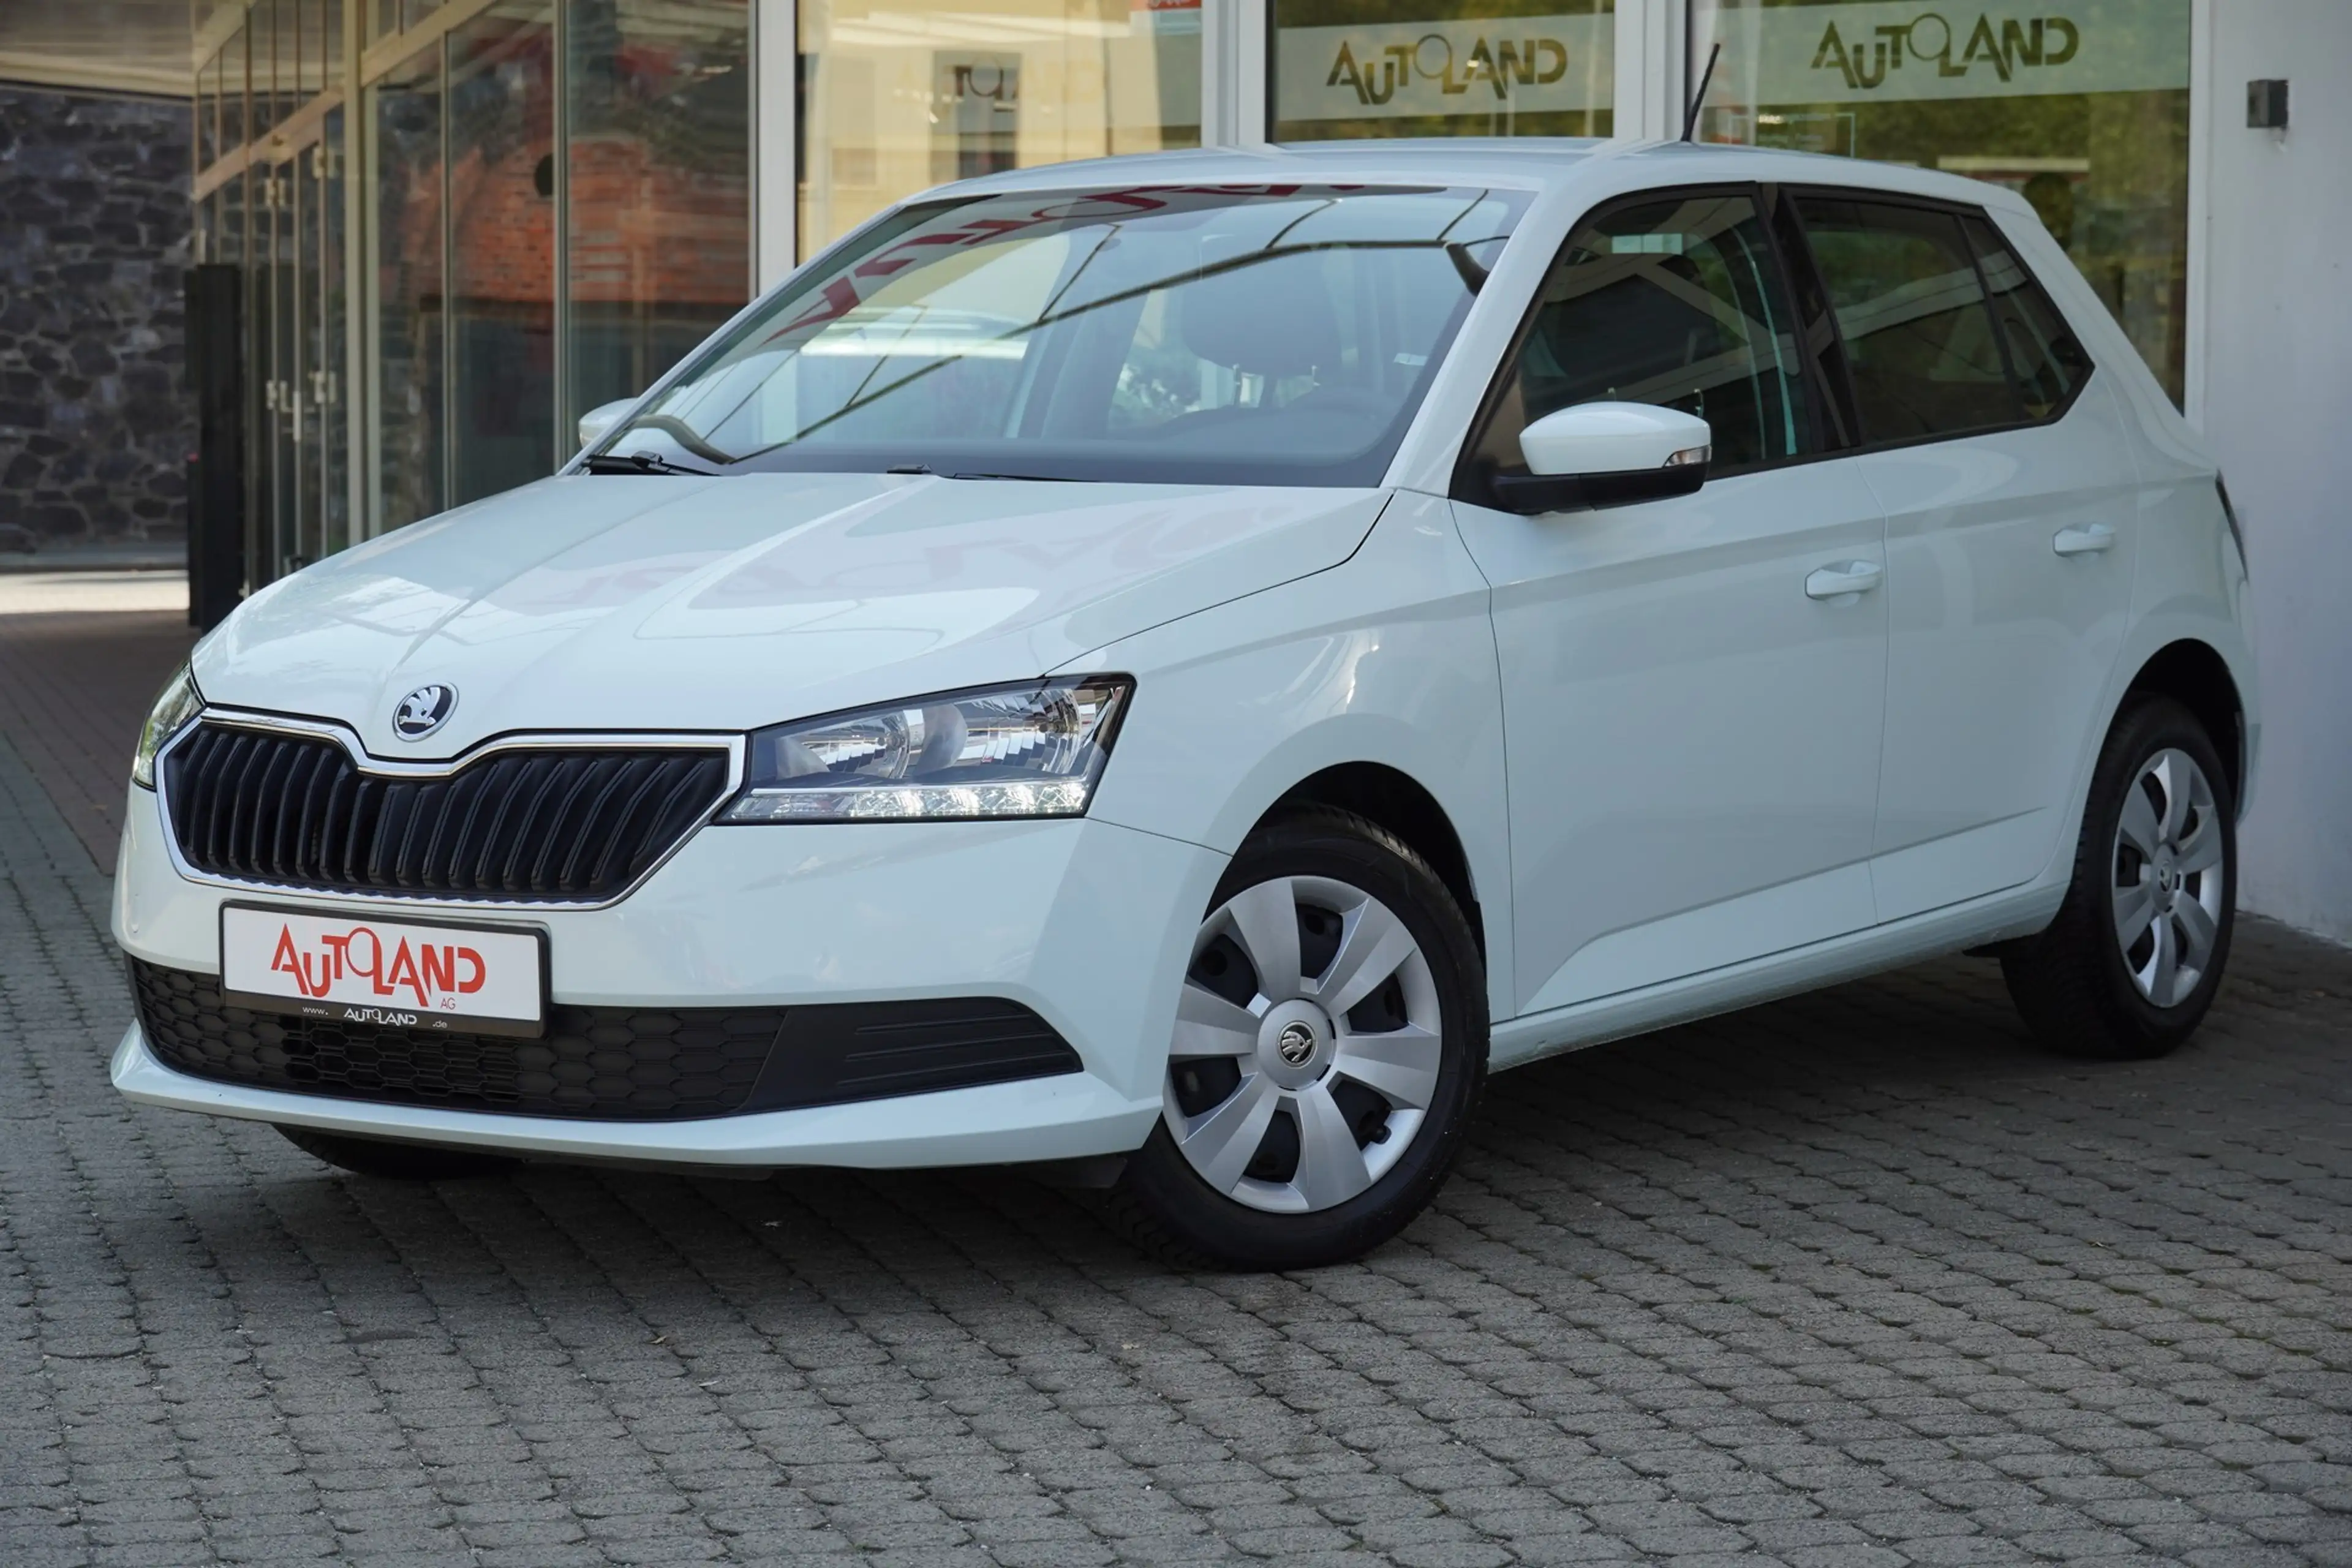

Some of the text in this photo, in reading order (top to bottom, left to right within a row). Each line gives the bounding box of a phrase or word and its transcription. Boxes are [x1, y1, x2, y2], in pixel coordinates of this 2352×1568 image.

[1326, 34, 1568, 105] AUTOLAND
[1811, 13, 2079, 89] AUTOLAND
[271, 922, 486, 1007] AUTOLAND
[303, 1006, 448, 1028] www. AUTOLAND .de
[440, 998, 456, 1010] AG
